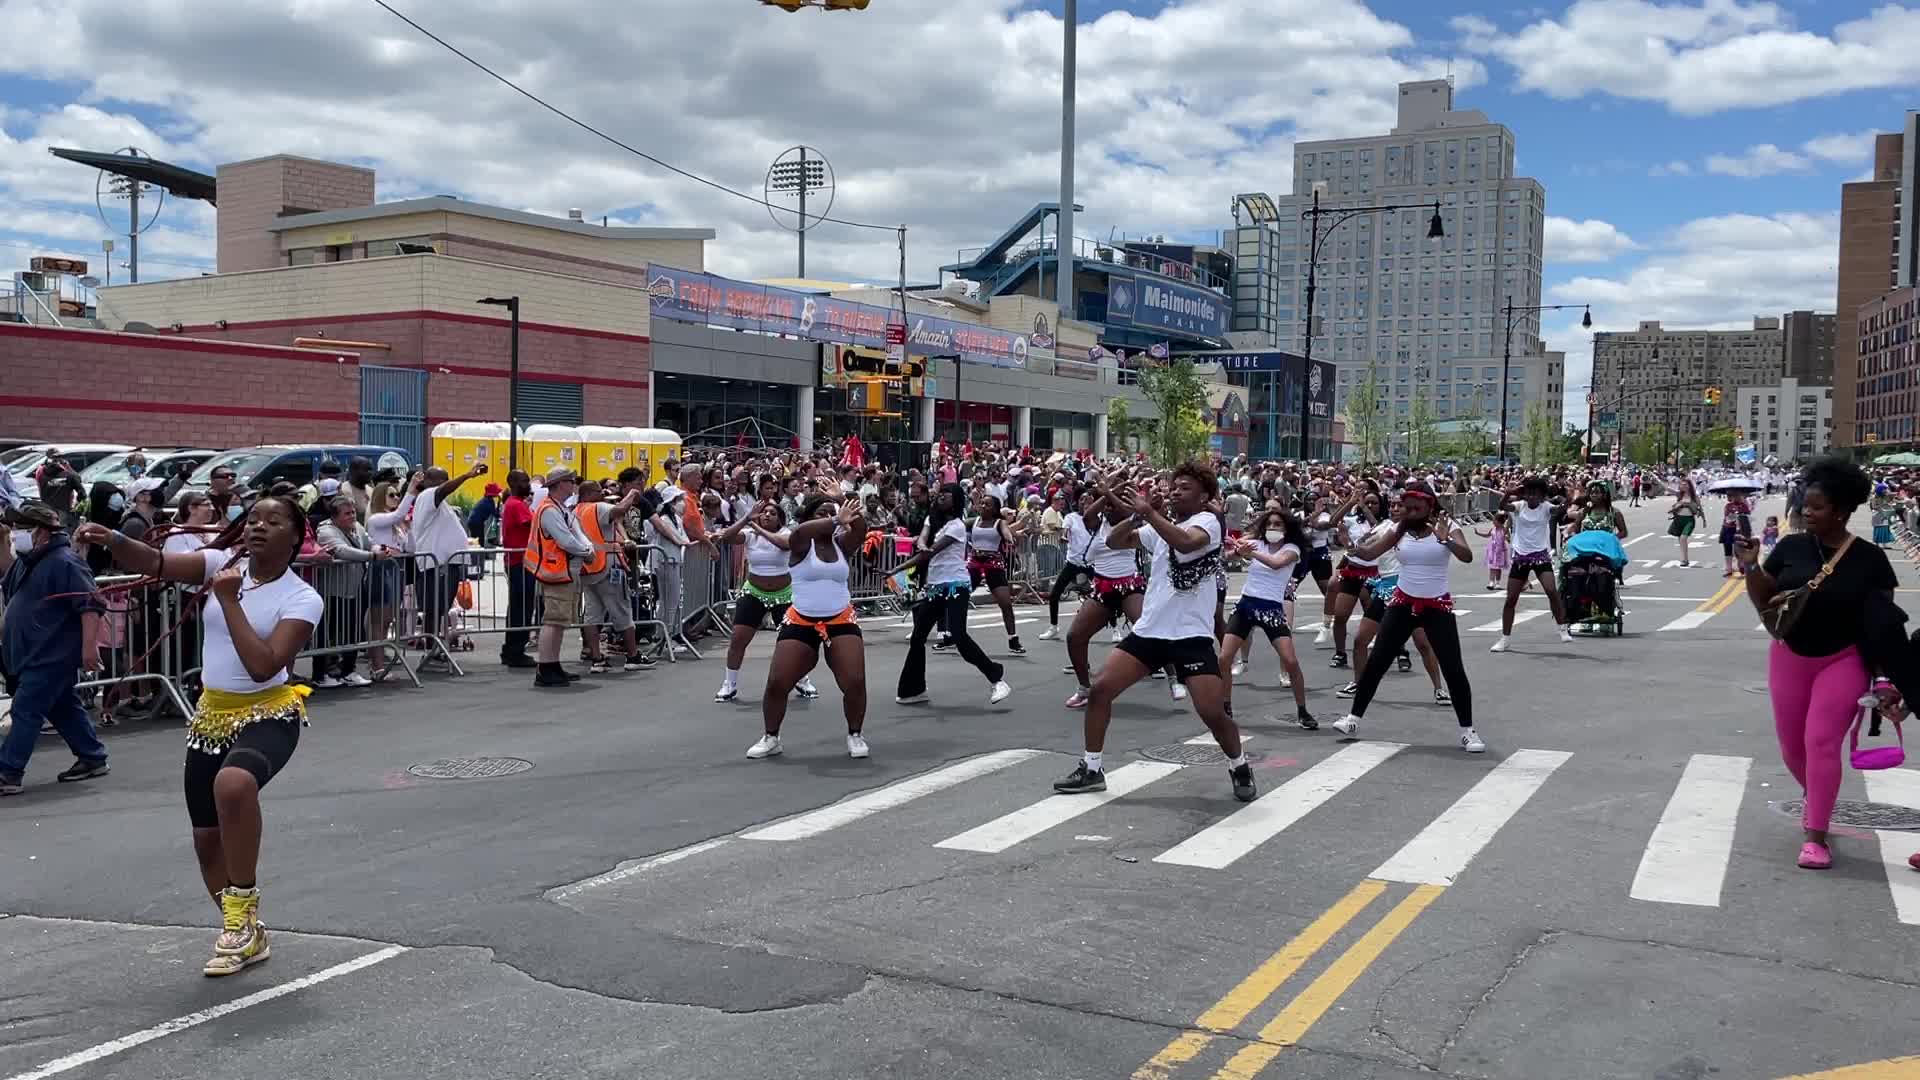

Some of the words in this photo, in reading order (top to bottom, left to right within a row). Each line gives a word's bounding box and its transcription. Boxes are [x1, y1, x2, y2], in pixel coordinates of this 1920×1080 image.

[679, 280, 722, 313] FROM
[1144, 285, 1216, 321] Maimonides
[824, 306, 841, 332] TO
[908, 320, 953, 349] Amazin'
